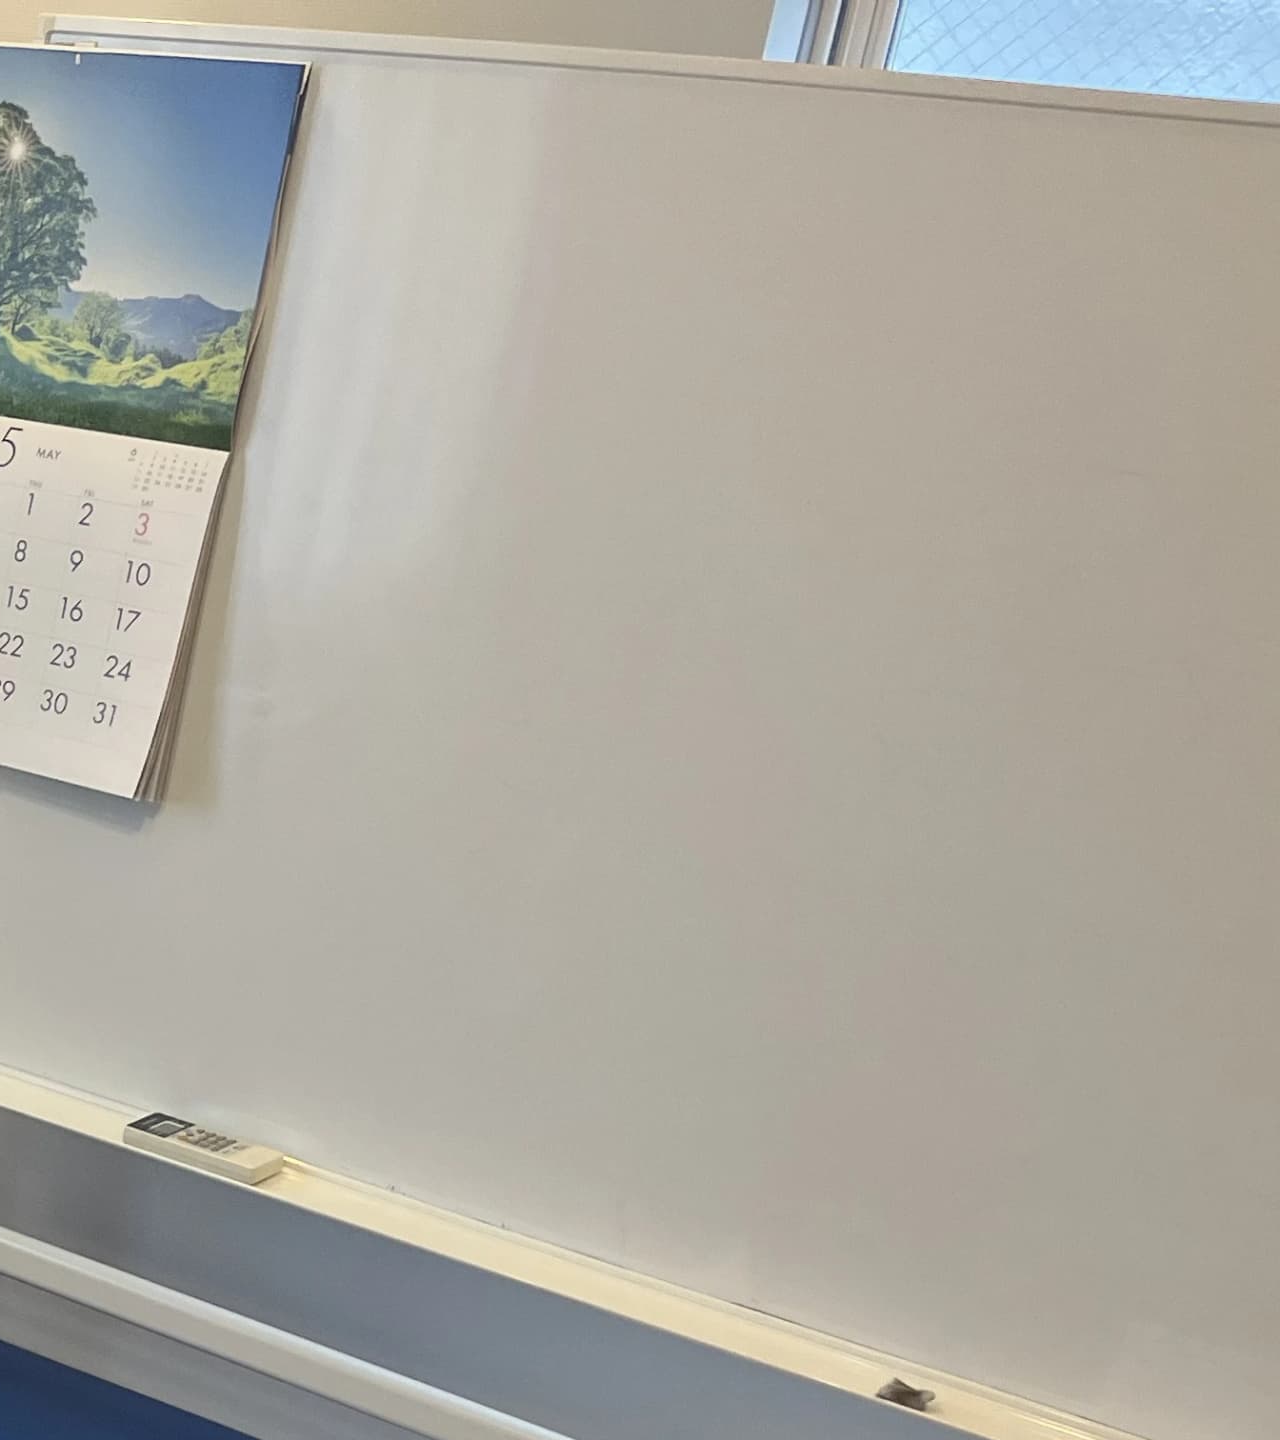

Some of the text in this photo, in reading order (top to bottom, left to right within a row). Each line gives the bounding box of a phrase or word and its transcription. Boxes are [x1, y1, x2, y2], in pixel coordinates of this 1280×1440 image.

[36, 448, 62, 461] MAY
[27, 492, 35, 516] 1
[78, 502, 94, 527] 2
[134, 512, 150, 536] 3
[14, 539, 27, 562] 8
[70, 550, 84, 573] 9
[126, 560, 151, 586] 10
[7, 585, 30, 611] 15
[61, 597, 83, 623] 16
[116, 607, 142, 632] 17
[49, 643, 78, 669] 23
[103, 655, 132, 682] 24
[39, 689, 69, 715] 30
[92, 701, 118, 727] 31
